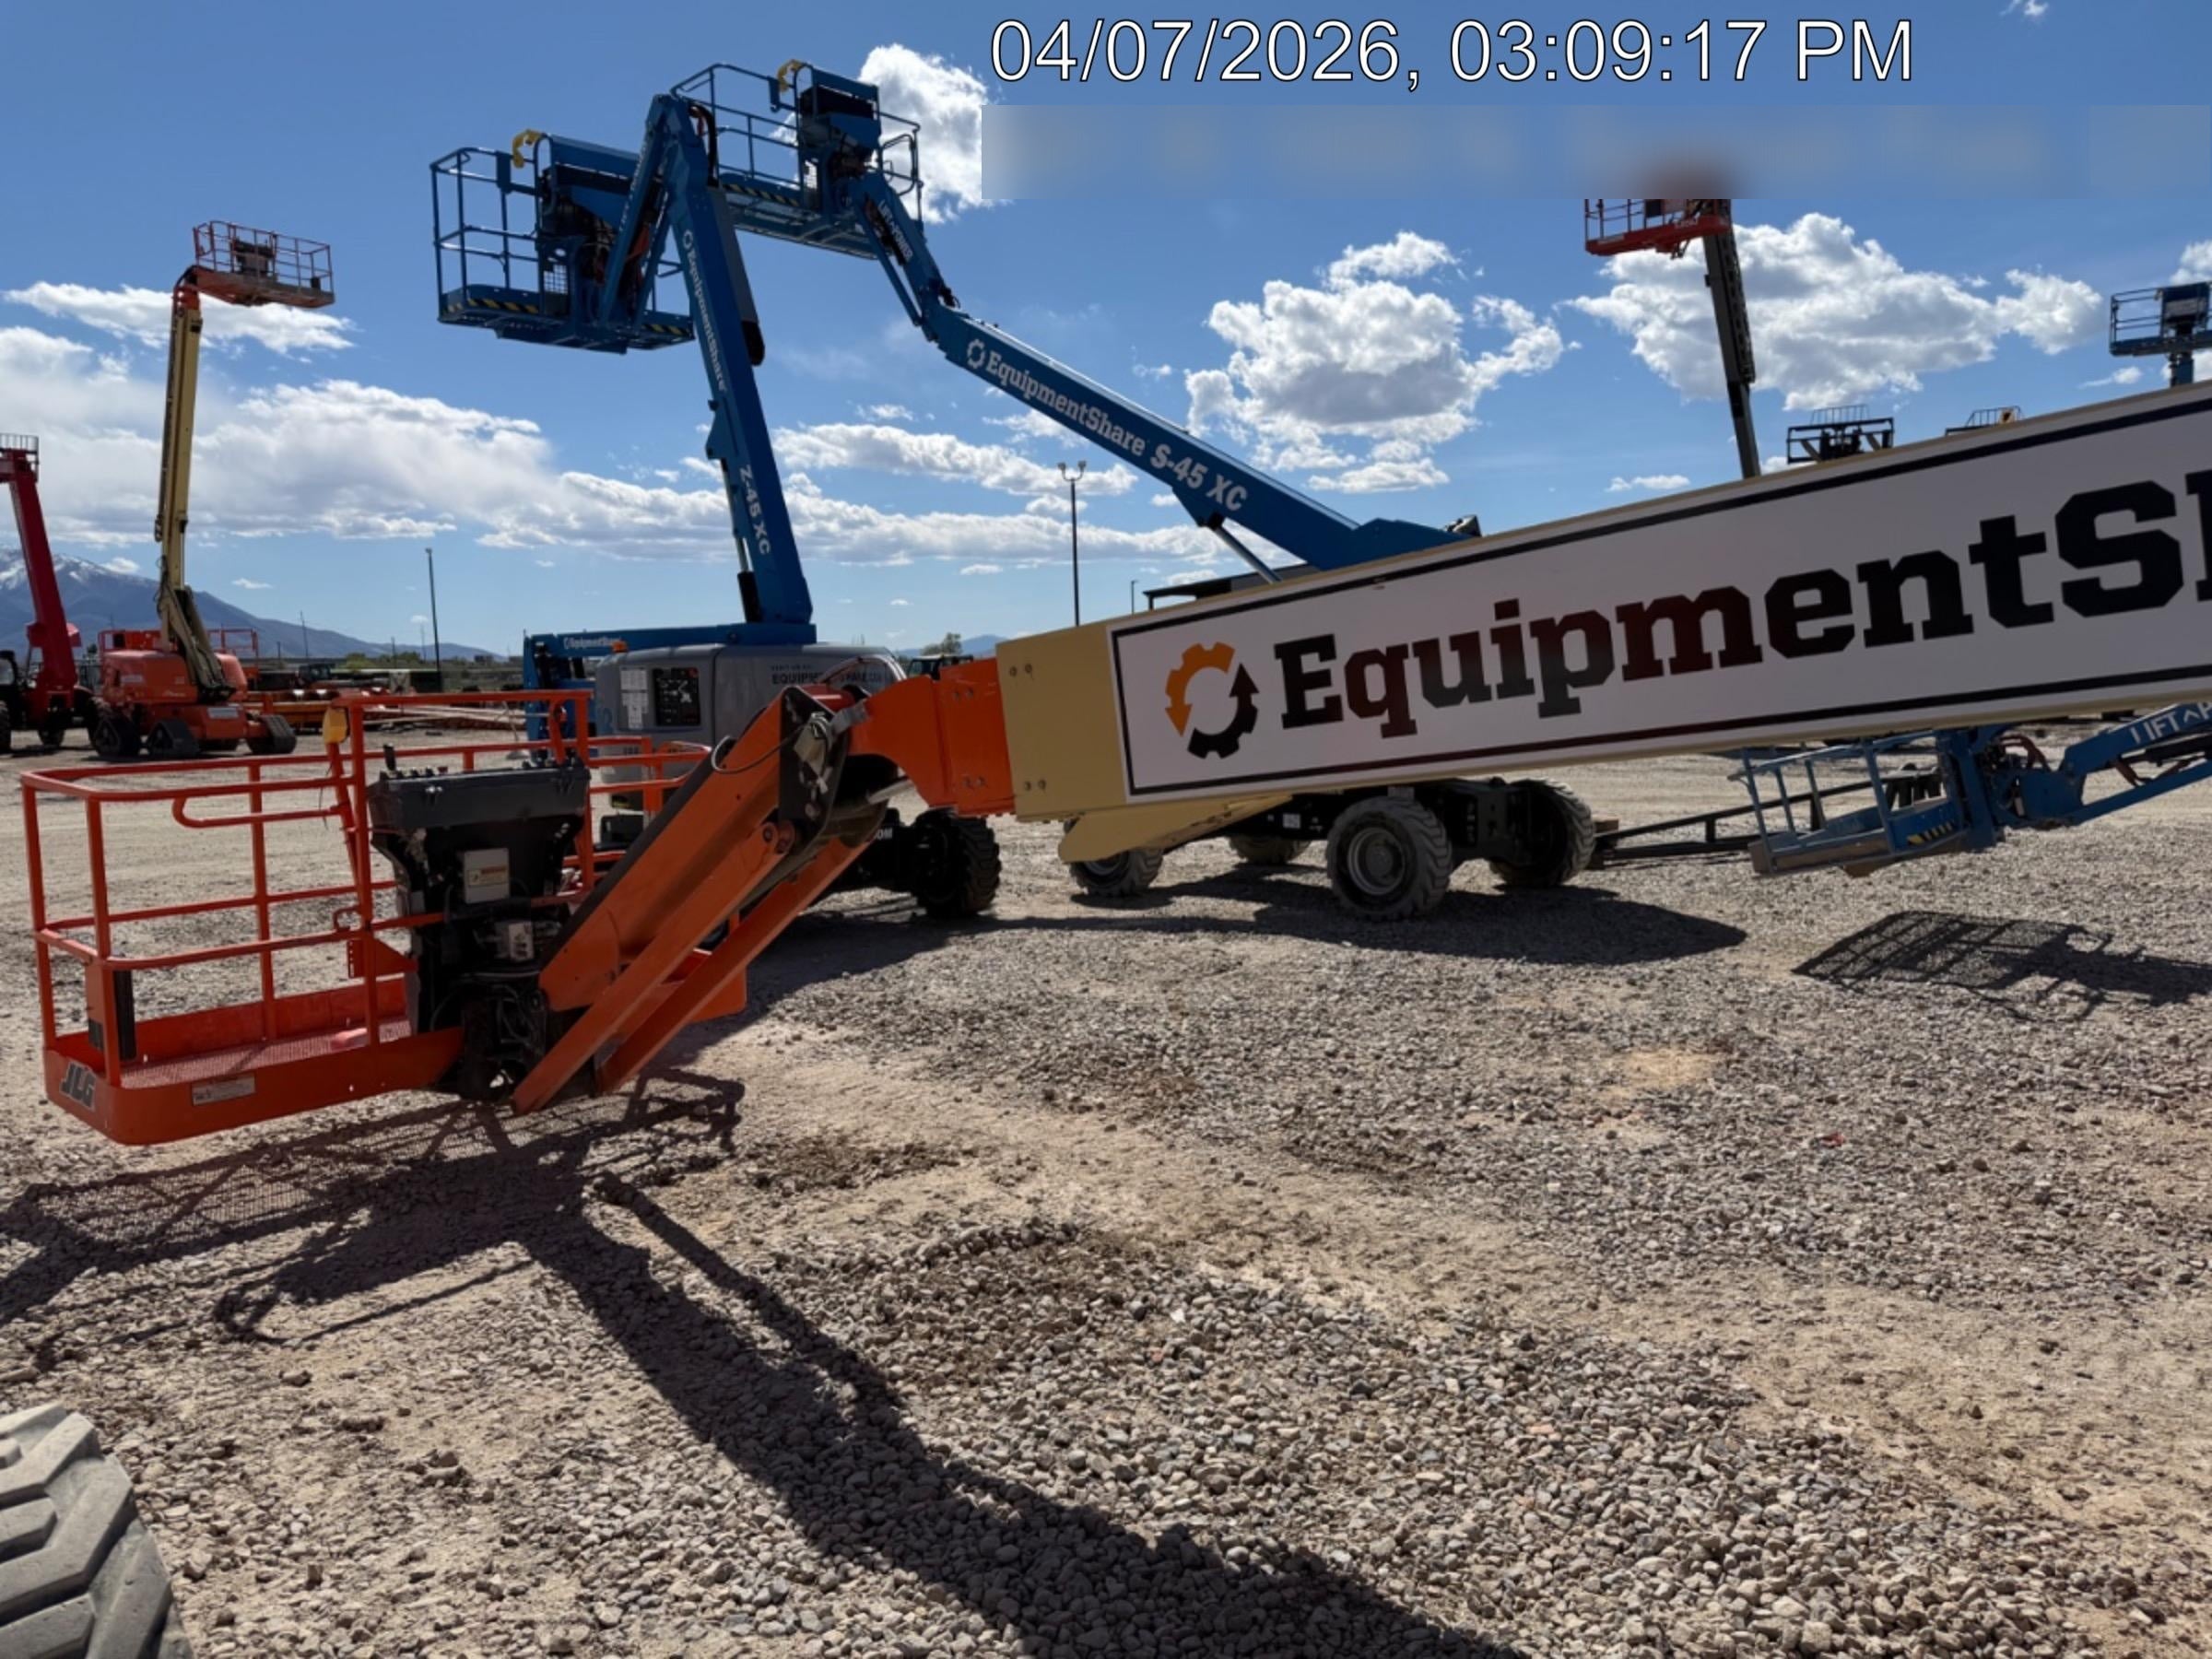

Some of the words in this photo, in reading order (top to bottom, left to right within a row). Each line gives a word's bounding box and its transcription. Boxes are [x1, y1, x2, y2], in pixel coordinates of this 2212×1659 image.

[987, 349, 1146, 457] EquipmentShare
[1150, 443, 1210, 489] S-45
[1206, 474, 1247, 512] XC
[753, 520, 771, 555] XC
[1274, 468, 2212, 740] EquipmentS
[59, 1060, 98, 1112] JLG
